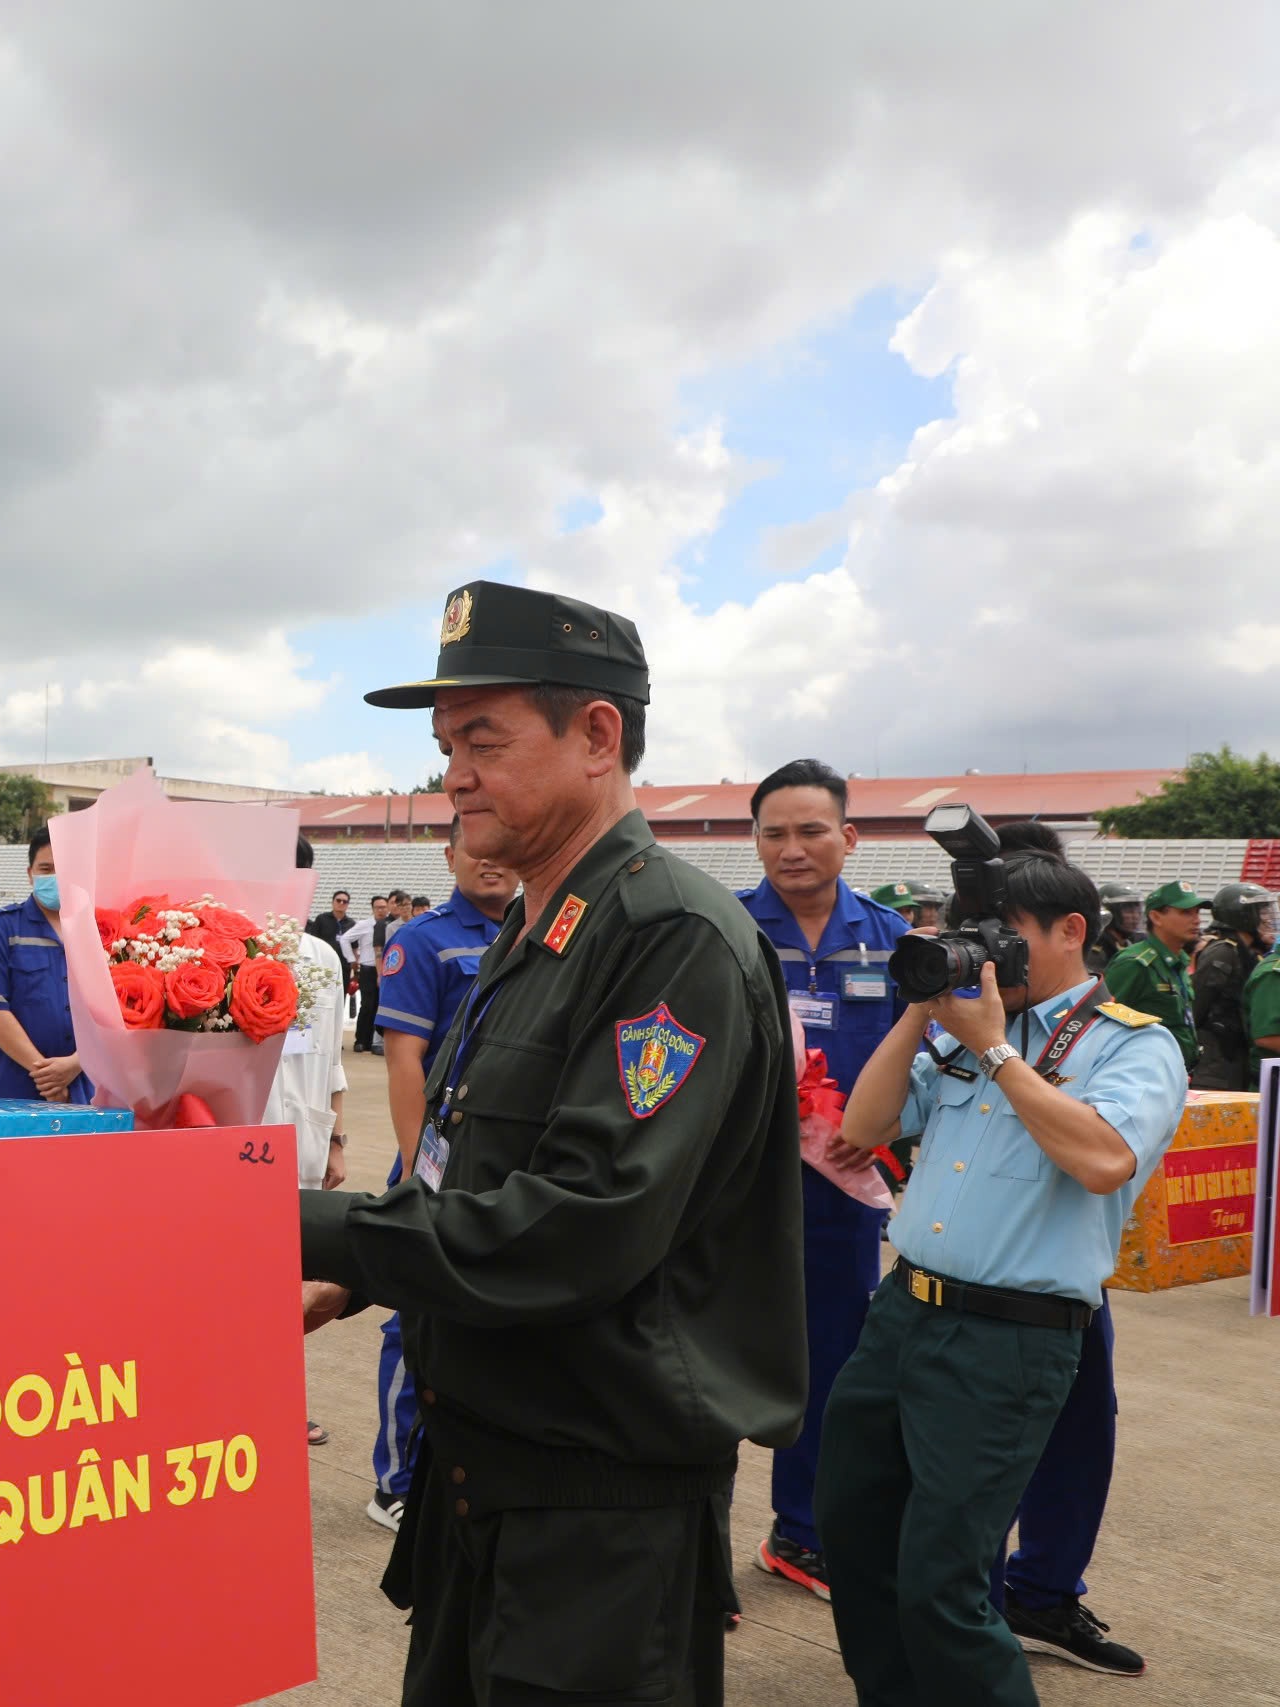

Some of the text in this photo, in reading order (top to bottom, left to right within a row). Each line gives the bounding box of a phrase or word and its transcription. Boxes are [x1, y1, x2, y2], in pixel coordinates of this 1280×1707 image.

[621, 1022, 695, 1056] CẢNH SÁT CƠ ĐỘNG
[1049, 1020, 1083, 1059] EOS 6D
[239, 1141, 275, 1164] 22
[166, 1434, 258, 1506] 370
